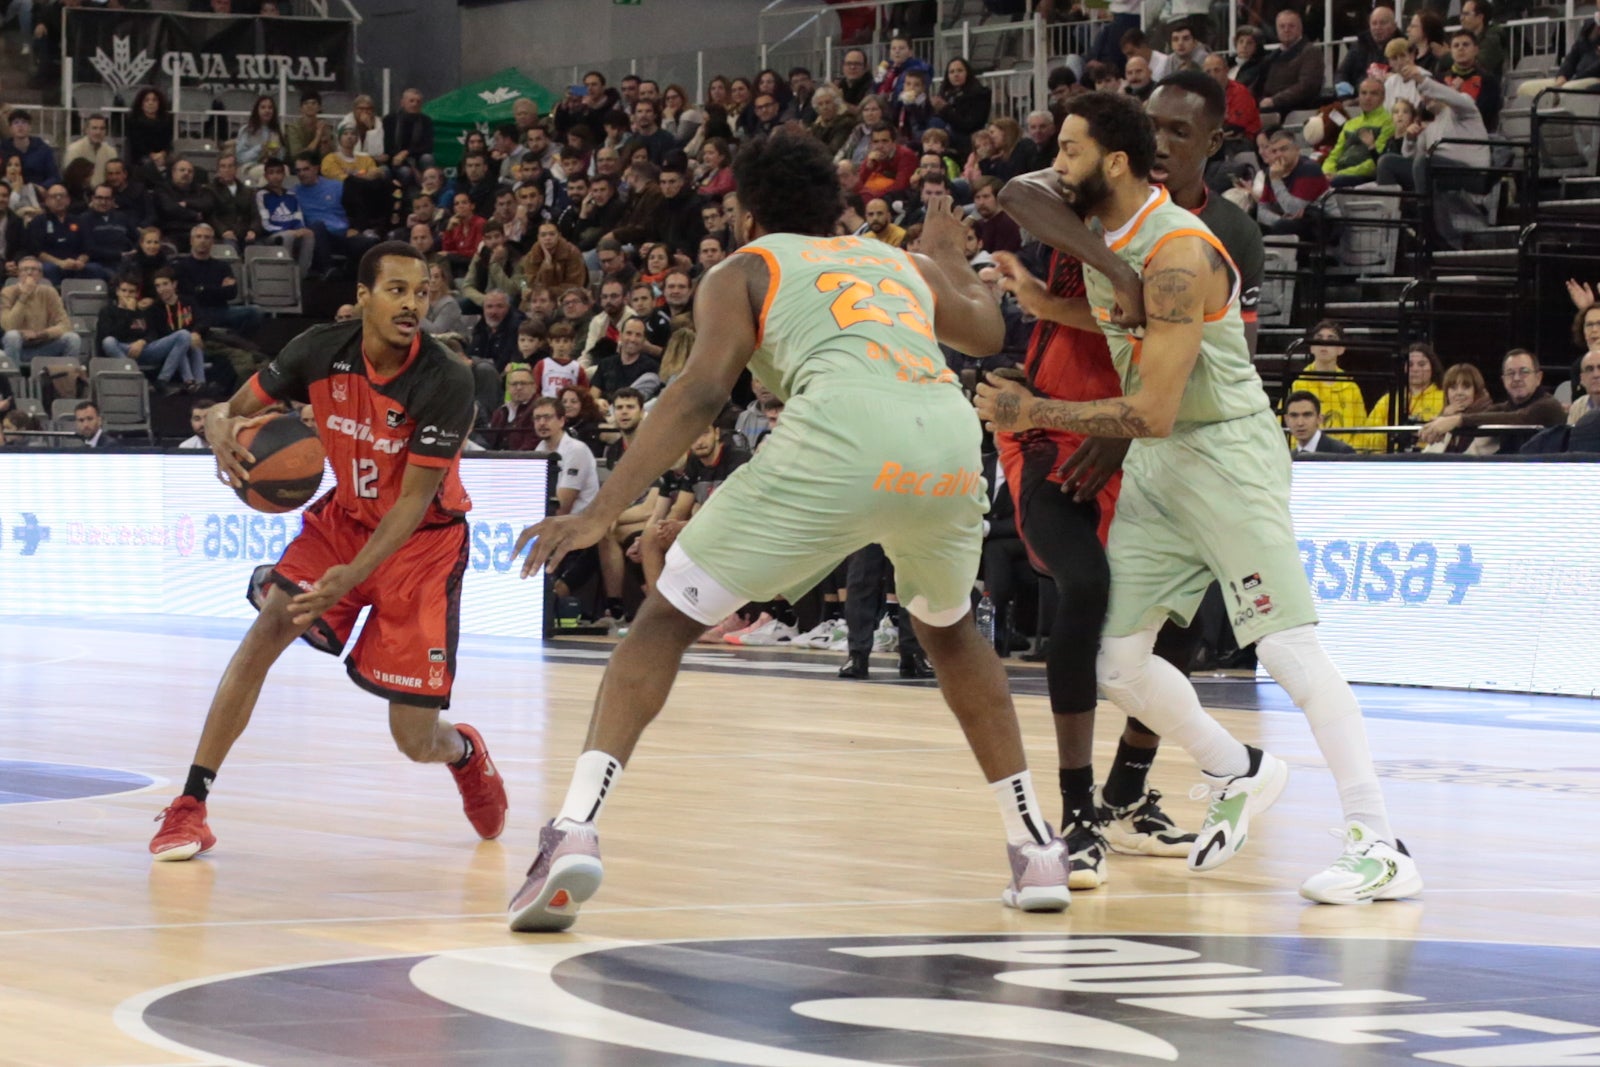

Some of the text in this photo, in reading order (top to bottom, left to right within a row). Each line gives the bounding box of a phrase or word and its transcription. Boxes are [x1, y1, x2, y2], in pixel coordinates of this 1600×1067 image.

[161, 51, 336, 82] CAJA RURAL
[814, 271, 935, 343] 23
[352, 458, 379, 499] 12
[203, 513, 287, 560] asisa
[381, 672, 423, 689] BERNER
